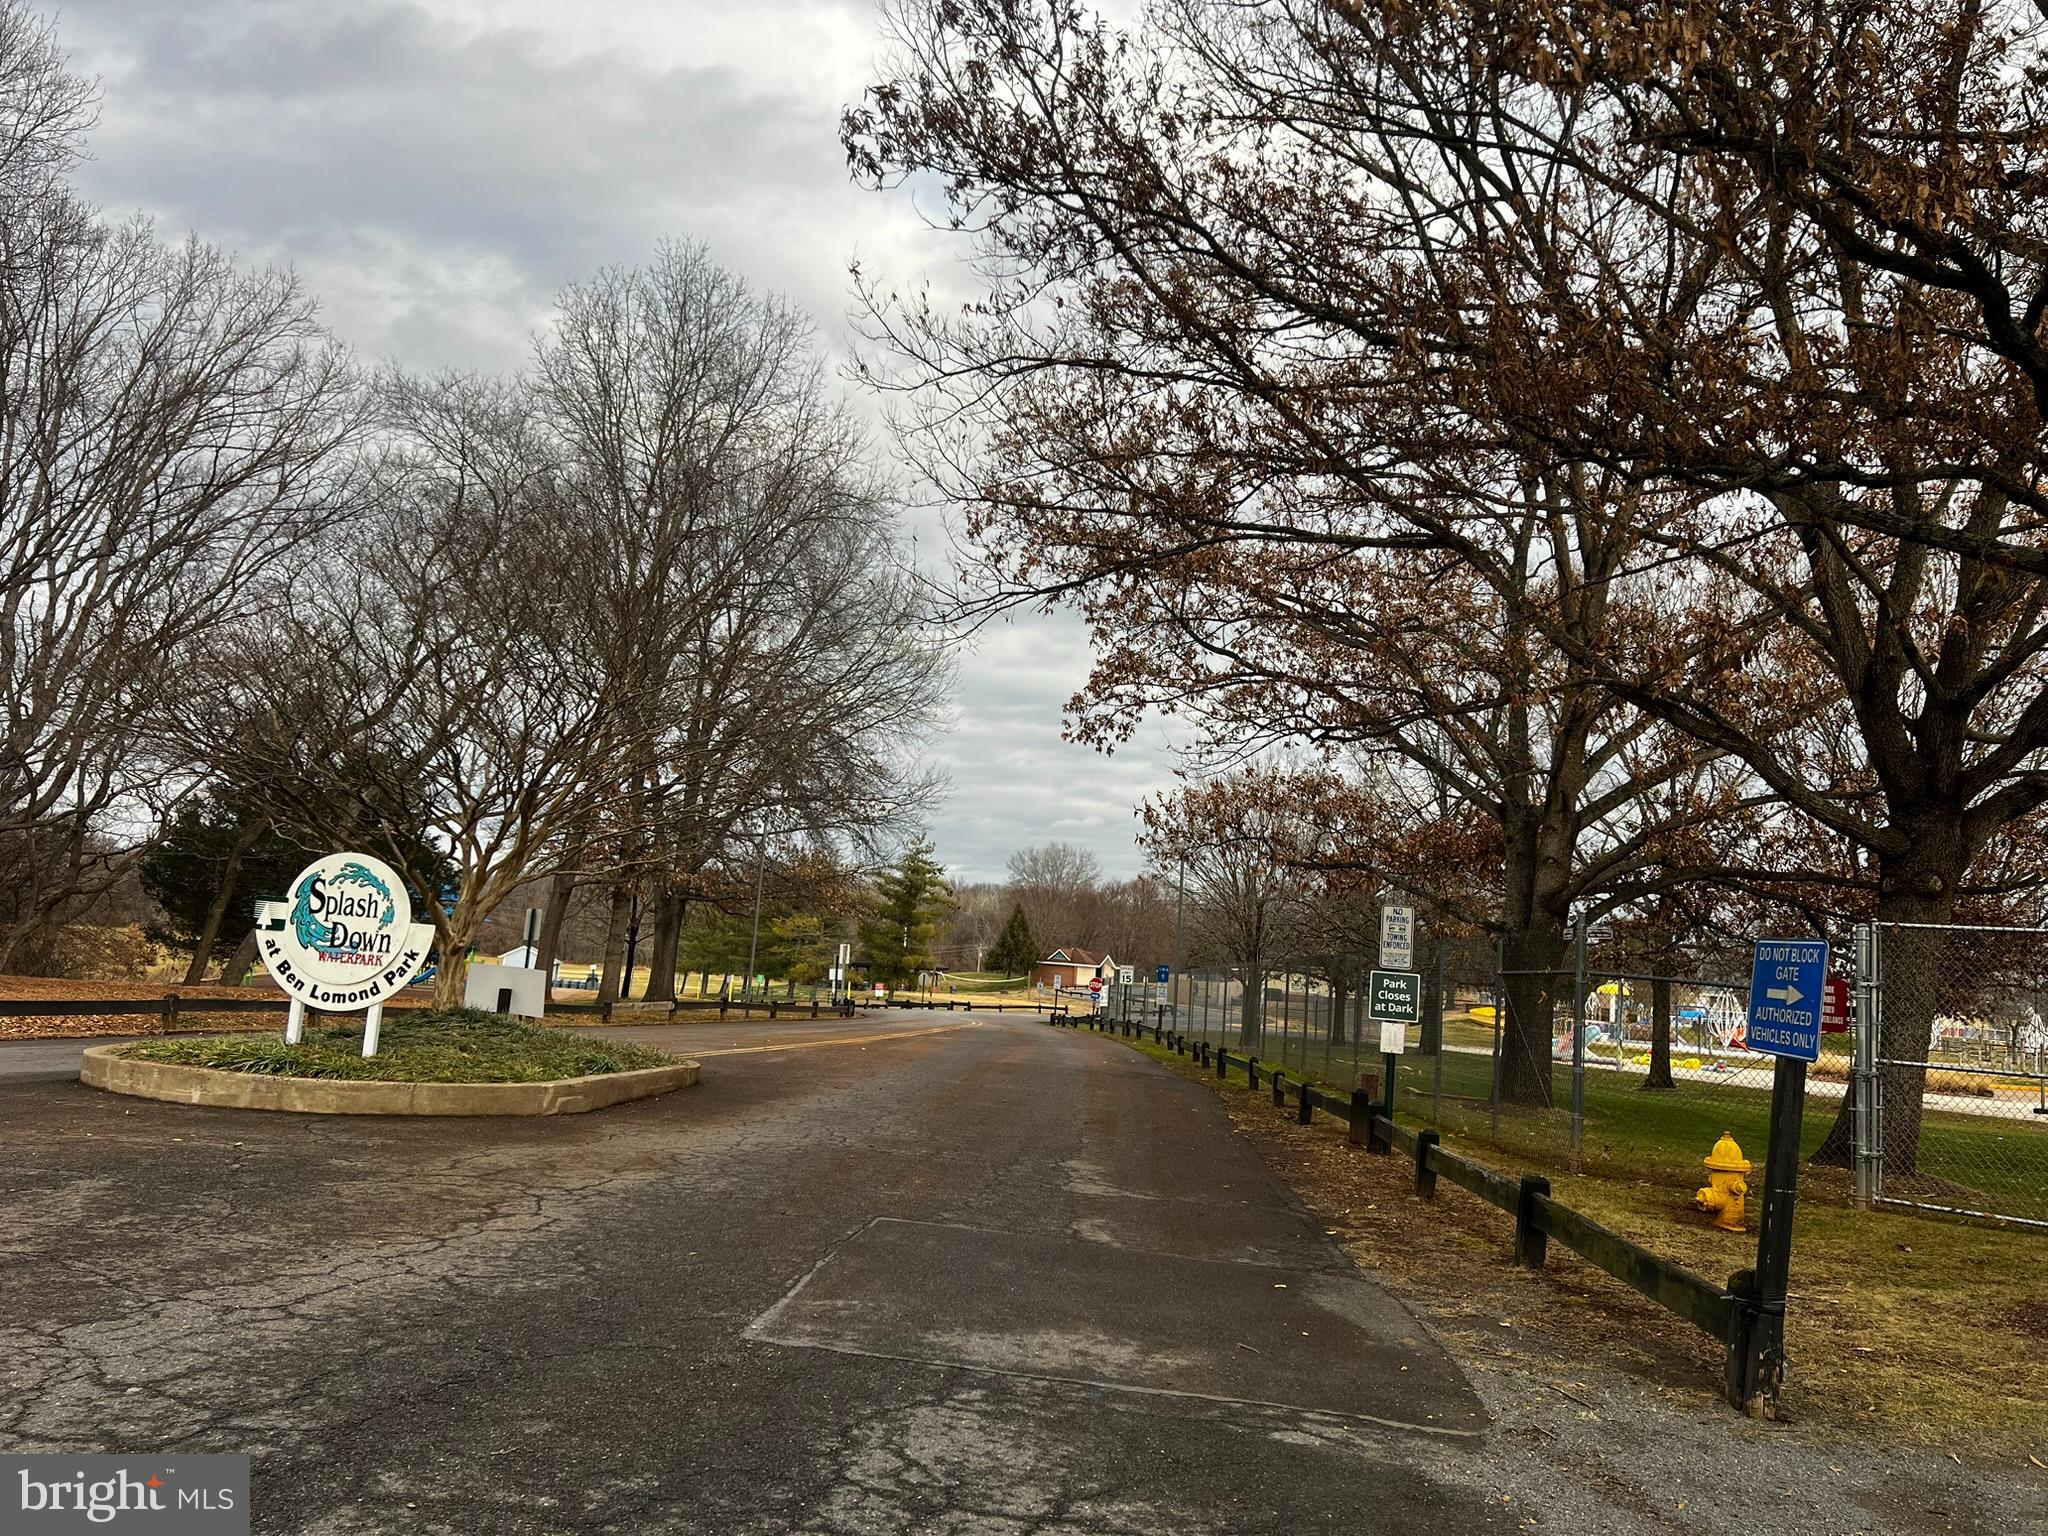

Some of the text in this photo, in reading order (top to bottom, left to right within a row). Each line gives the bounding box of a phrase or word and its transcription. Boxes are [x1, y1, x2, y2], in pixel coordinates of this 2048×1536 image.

[309, 878, 379, 922] Splash
[1393, 908, 1404, 916] NO
[1386, 915, 1410, 925] PARKING
[330, 921, 391, 954] Down
[1387, 933, 1408, 942] TOWING
[1383, 941, 1410, 950] ENFORCED
[318, 952, 383, 966] WATERPARK
[1760, 947, 1820, 963] DO NOT BLOCK
[265, 938, 420, 1004] at Ben Lomond Park
[1776, 966, 1799, 981] GATE
[1122, 975, 1132, 983] 15
[1383, 978, 1407, 989] Park
[1824, 985, 1835, 993] ARK
[1378, 990, 1411, 1001] Closes
[1374, 1003, 1413, 1013] at Dark
[1755, 1006, 1812, 1026] AUTHORIZED
[1751, 1026, 1816, 1049] VEHICLES ONLY
